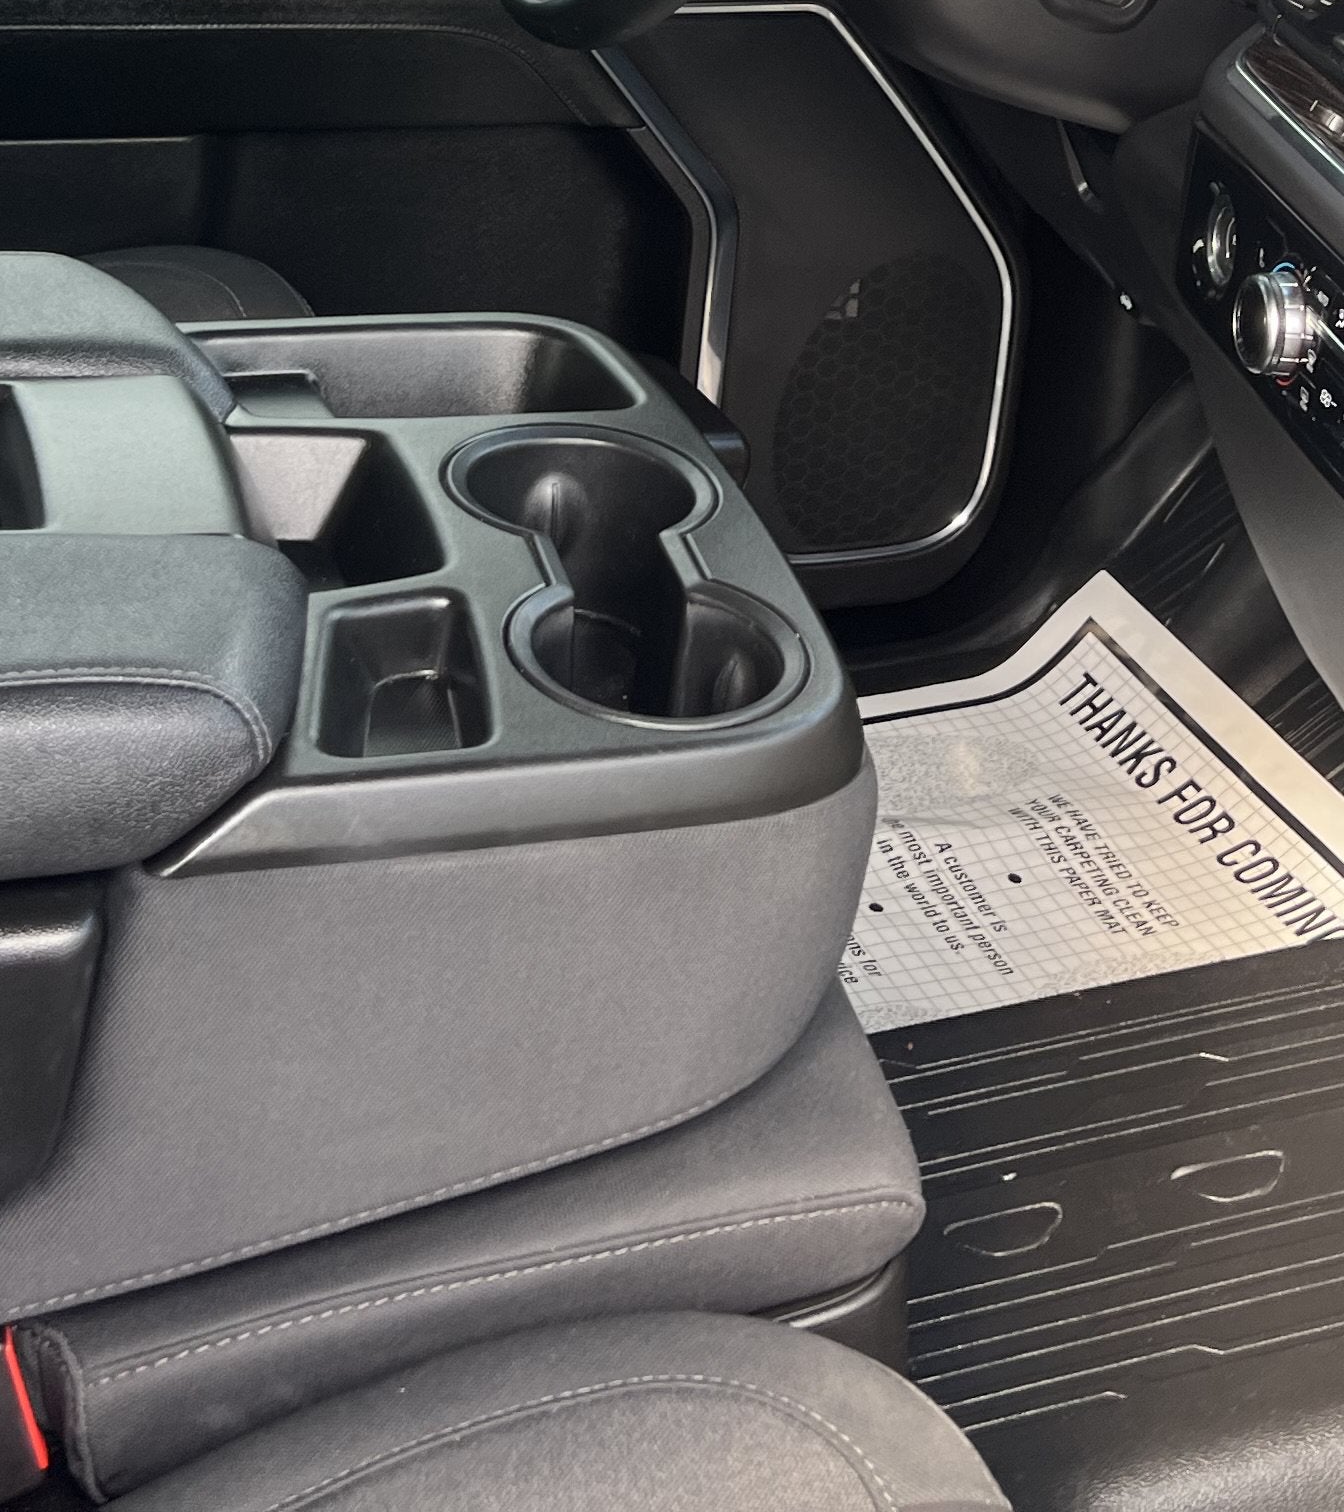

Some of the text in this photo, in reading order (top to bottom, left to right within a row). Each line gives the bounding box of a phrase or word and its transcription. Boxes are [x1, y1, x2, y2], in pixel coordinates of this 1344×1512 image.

[1059, 671, 1177, 788] THANKS
[1156, 778, 1235, 845] FOR
[877, 838, 894, 854] in
[887, 855, 909, 879] the
[904, 881, 940, 918] world
[931, 918, 950, 933] to
[899, 831, 933, 866] most
[923, 868, 981, 931] important
[968, 933, 1014, 976] person
[934, 841, 1008, 933] A customer is
[1008, 807, 1129, 935] WITH THIS PAPER MAT
[1025, 798, 1158, 937] YOUR CARPETING CLEAN
[1048, 793, 1180, 929] WE HAVE TRIED TO KEEP
